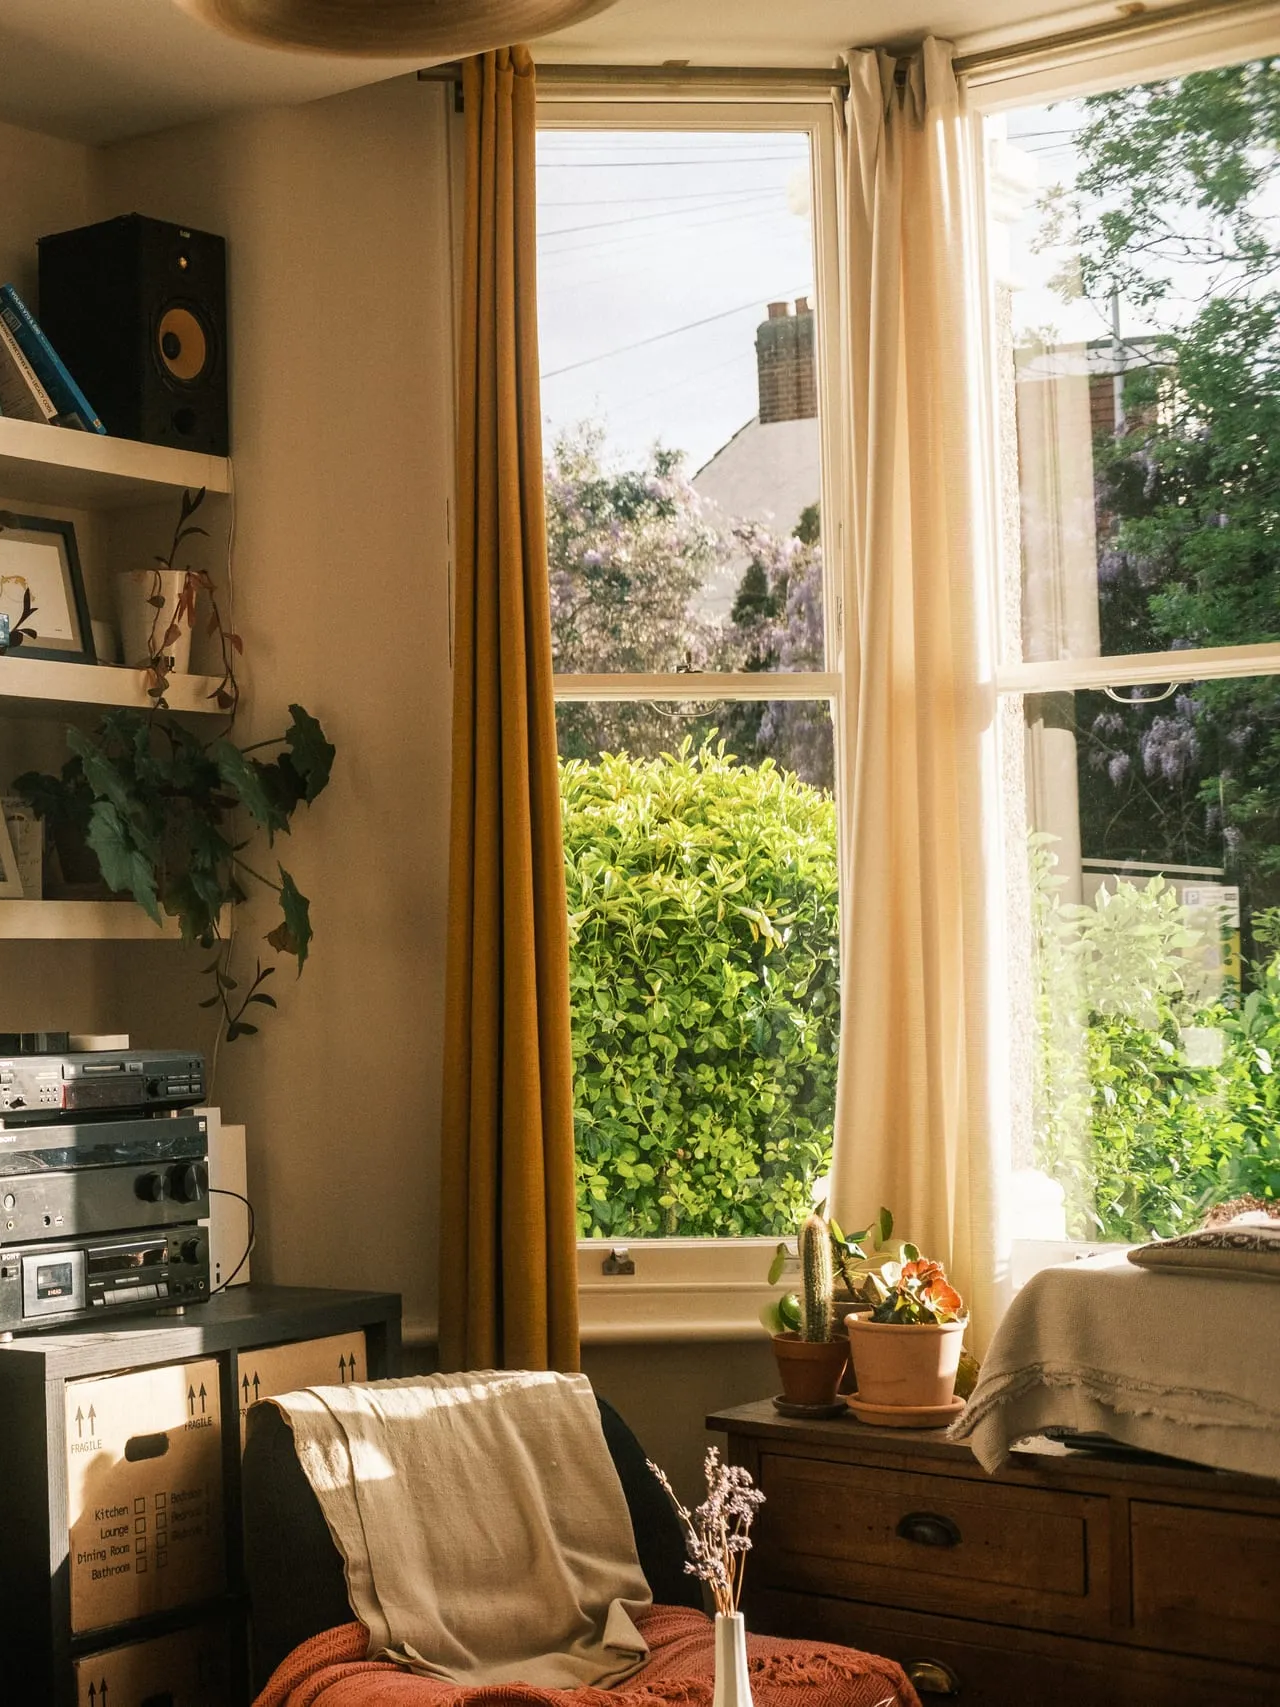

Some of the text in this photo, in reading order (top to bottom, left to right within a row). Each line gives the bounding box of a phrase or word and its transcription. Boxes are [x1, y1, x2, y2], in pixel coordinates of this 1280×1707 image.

[1, 1252, 21, 1261] SONY
[184, 1416, 213, 1431] FRAGILE
[70, 1439, 103, 1454] FRAGILE
[94, 1505, 129, 1521] Kitchen
[100, 1525, 129, 1540] Lounge
[77, 1544, 130, 1565] Dining Room
[91, 1563, 131, 1581] Bathroom
